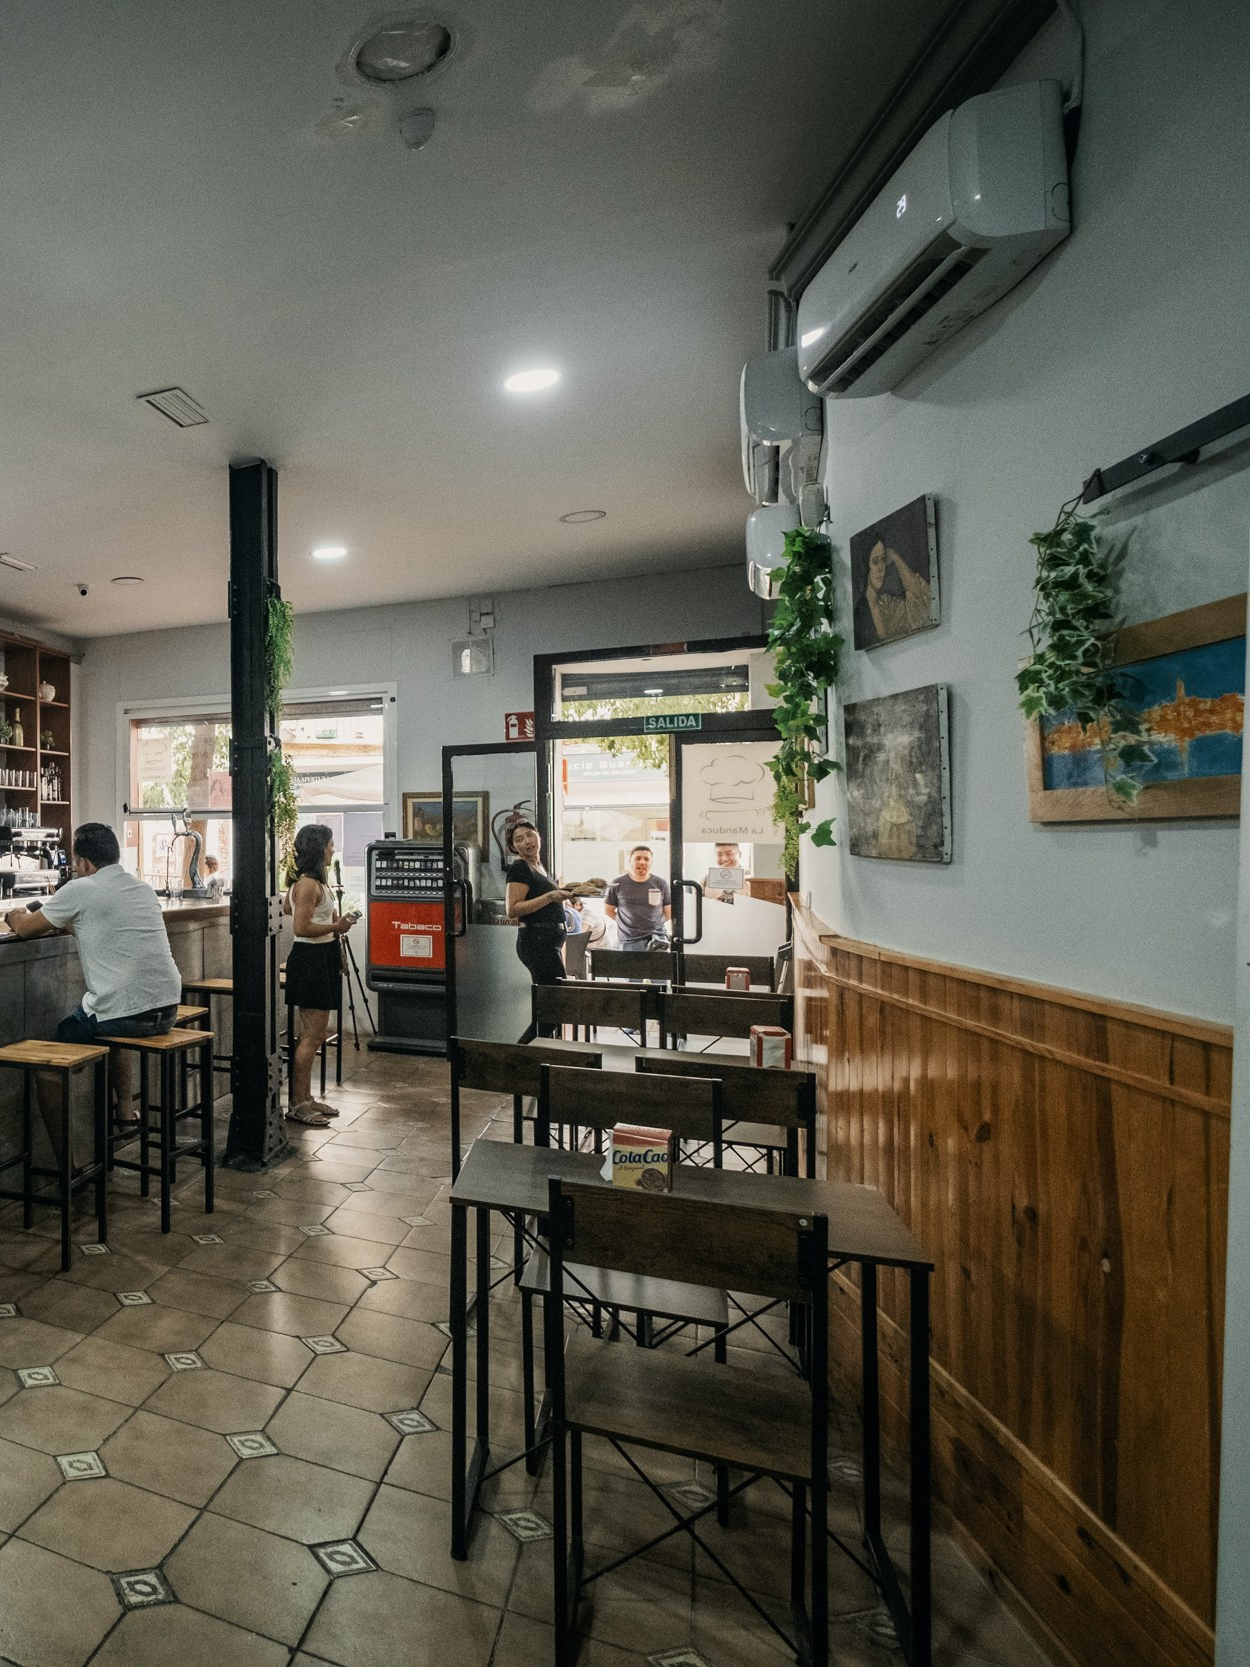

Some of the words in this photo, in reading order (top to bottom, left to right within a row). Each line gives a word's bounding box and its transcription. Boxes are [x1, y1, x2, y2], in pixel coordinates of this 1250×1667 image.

[648, 715, 697, 729] SALIDA
[391, 921, 442, 931] Tabaco
[613, 1149, 669, 1164] ColaCao
